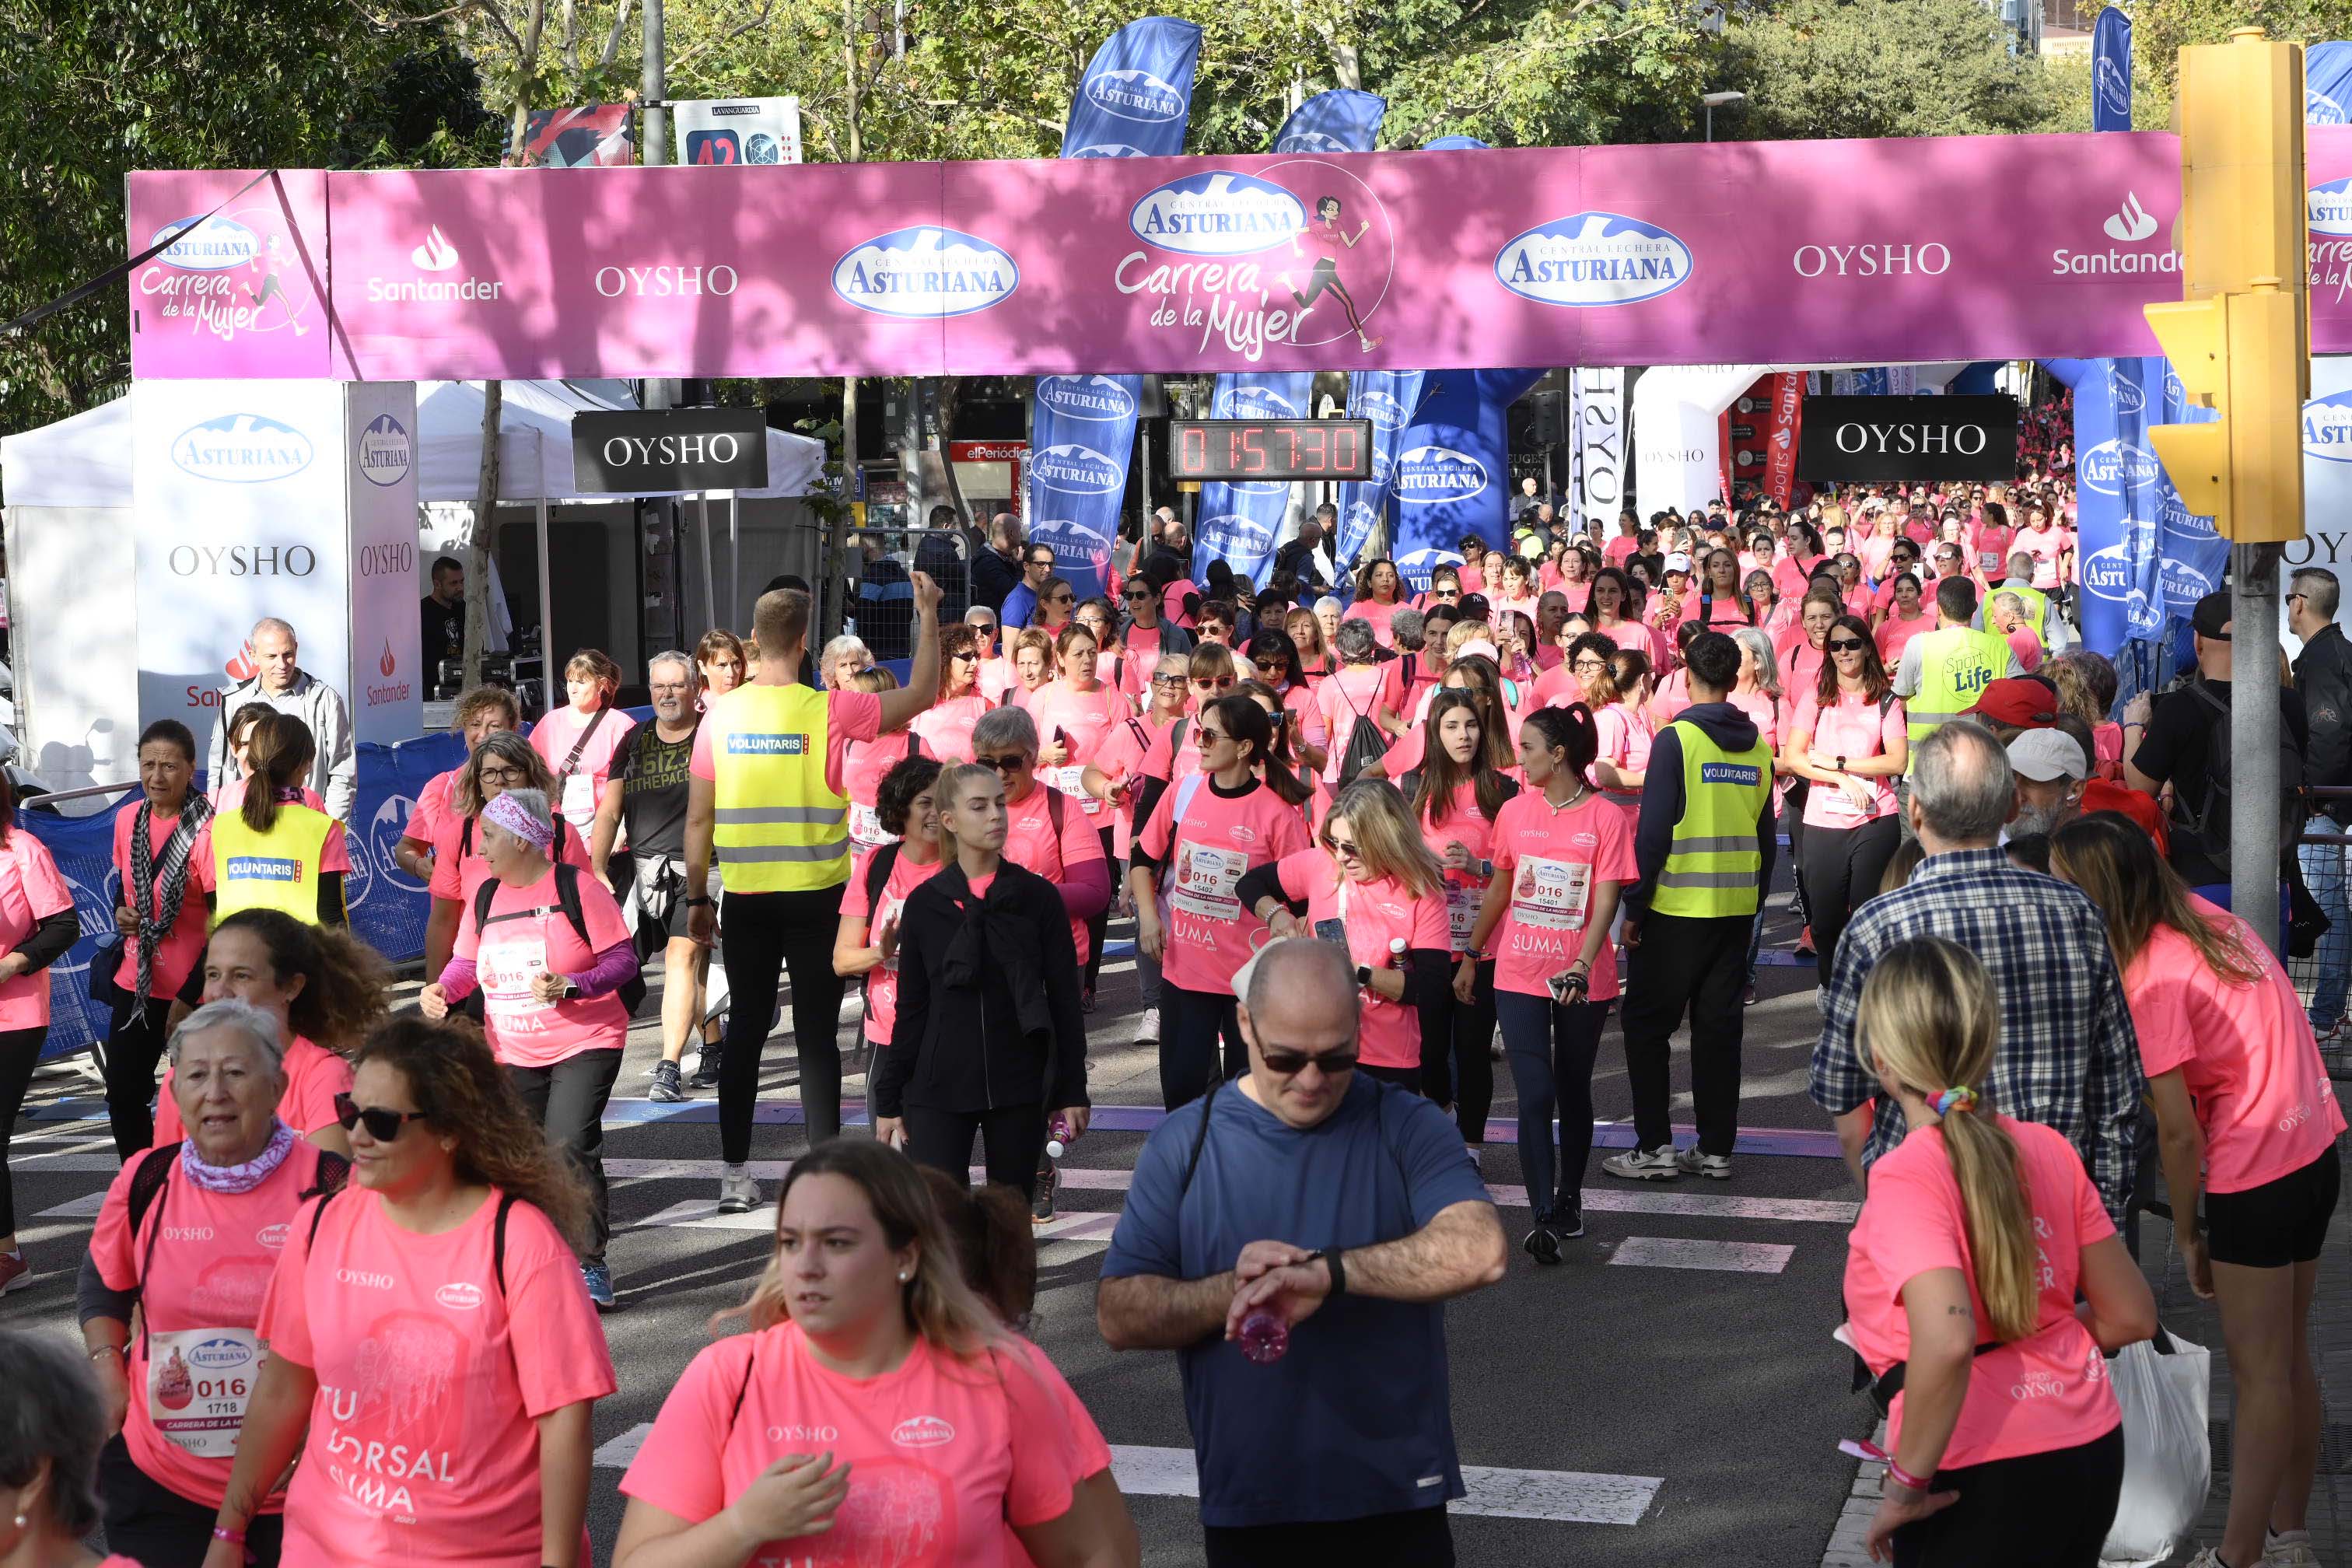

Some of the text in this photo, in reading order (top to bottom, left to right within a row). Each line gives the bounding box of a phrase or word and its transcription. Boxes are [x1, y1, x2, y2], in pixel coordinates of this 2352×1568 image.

[722, 106, 759, 114] VANGUARDIA
[1092, 80, 1176, 116] ASTURIANA
[1143, 203, 1293, 234] ASTURIANA
[159, 234, 251, 257] ASTURIANA
[1115, 250, 1261, 294] Carrera
[1510, 248, 1678, 283] ASTURIANA
[1793, 242, 1951, 278] OYSHO
[140, 265, 232, 296] Carrera
[595, 264, 739, 297] OYSHO
[846, 261, 1005, 294] ASTURIANA
[2326, 264, 2340, 285] la
[368, 277, 503, 302] Santander
[162, 293, 267, 341] de la Mujer
[1150, 289, 1314, 362] de la Mujer
[1045, 383, 1126, 414] ASTURIANA
[184, 438, 303, 465] ASTURIANA
[604, 433, 739, 467] OYSHO
[1183, 429, 1357, 472] 01:57:30
[1836, 423, 1986, 454] OYSHO
[363, 440, 408, 468] ASTURIANA
[1038, 456, 1116, 487] ASTURIANA
[1392, 470, 1481, 491] ASTURIANA
[1203, 524, 1269, 553] ASTURIANA
[2280, 532, 2352, 565] OY
[169, 544, 317, 577] OYSHO
[360, 541, 413, 578] OYSHO
[1946, 651, 1984, 674] Sport
[366, 679, 411, 707] Santander
[1955, 666, 1993, 693] Life
[728, 738, 800, 750] VOLUNTARIS
[227, 862, 292, 877] VOLUNTARIS
[1192, 871, 1219, 886] 016
[1193, 884, 1214, 894] 15402
[1538, 884, 1563, 898] 016
[1538, 897, 1559, 907] 15401
[1210, 905, 1234, 915] Santander
[1517, 912, 1538, 922] OYSHO
[1174, 919, 1216, 946] UMA
[1512, 933, 1565, 955] SUMA
[500, 971, 524, 983] 016
[163, 1227, 214, 1241] OYSHO
[336, 1269, 394, 1290] OYSHO
[194, 1351, 247, 1362] ASTURIANA
[197, 1378, 247, 1398] 016
[207, 1402, 237, 1414] 1718
[321, 1385, 358, 1421] TU
[166, 1419, 205, 1430] CARRERA
[206, 1419, 219, 1428] DE
[220, 1419, 231, 1427] LA
[767, 1424, 838, 1443] OYSHO
